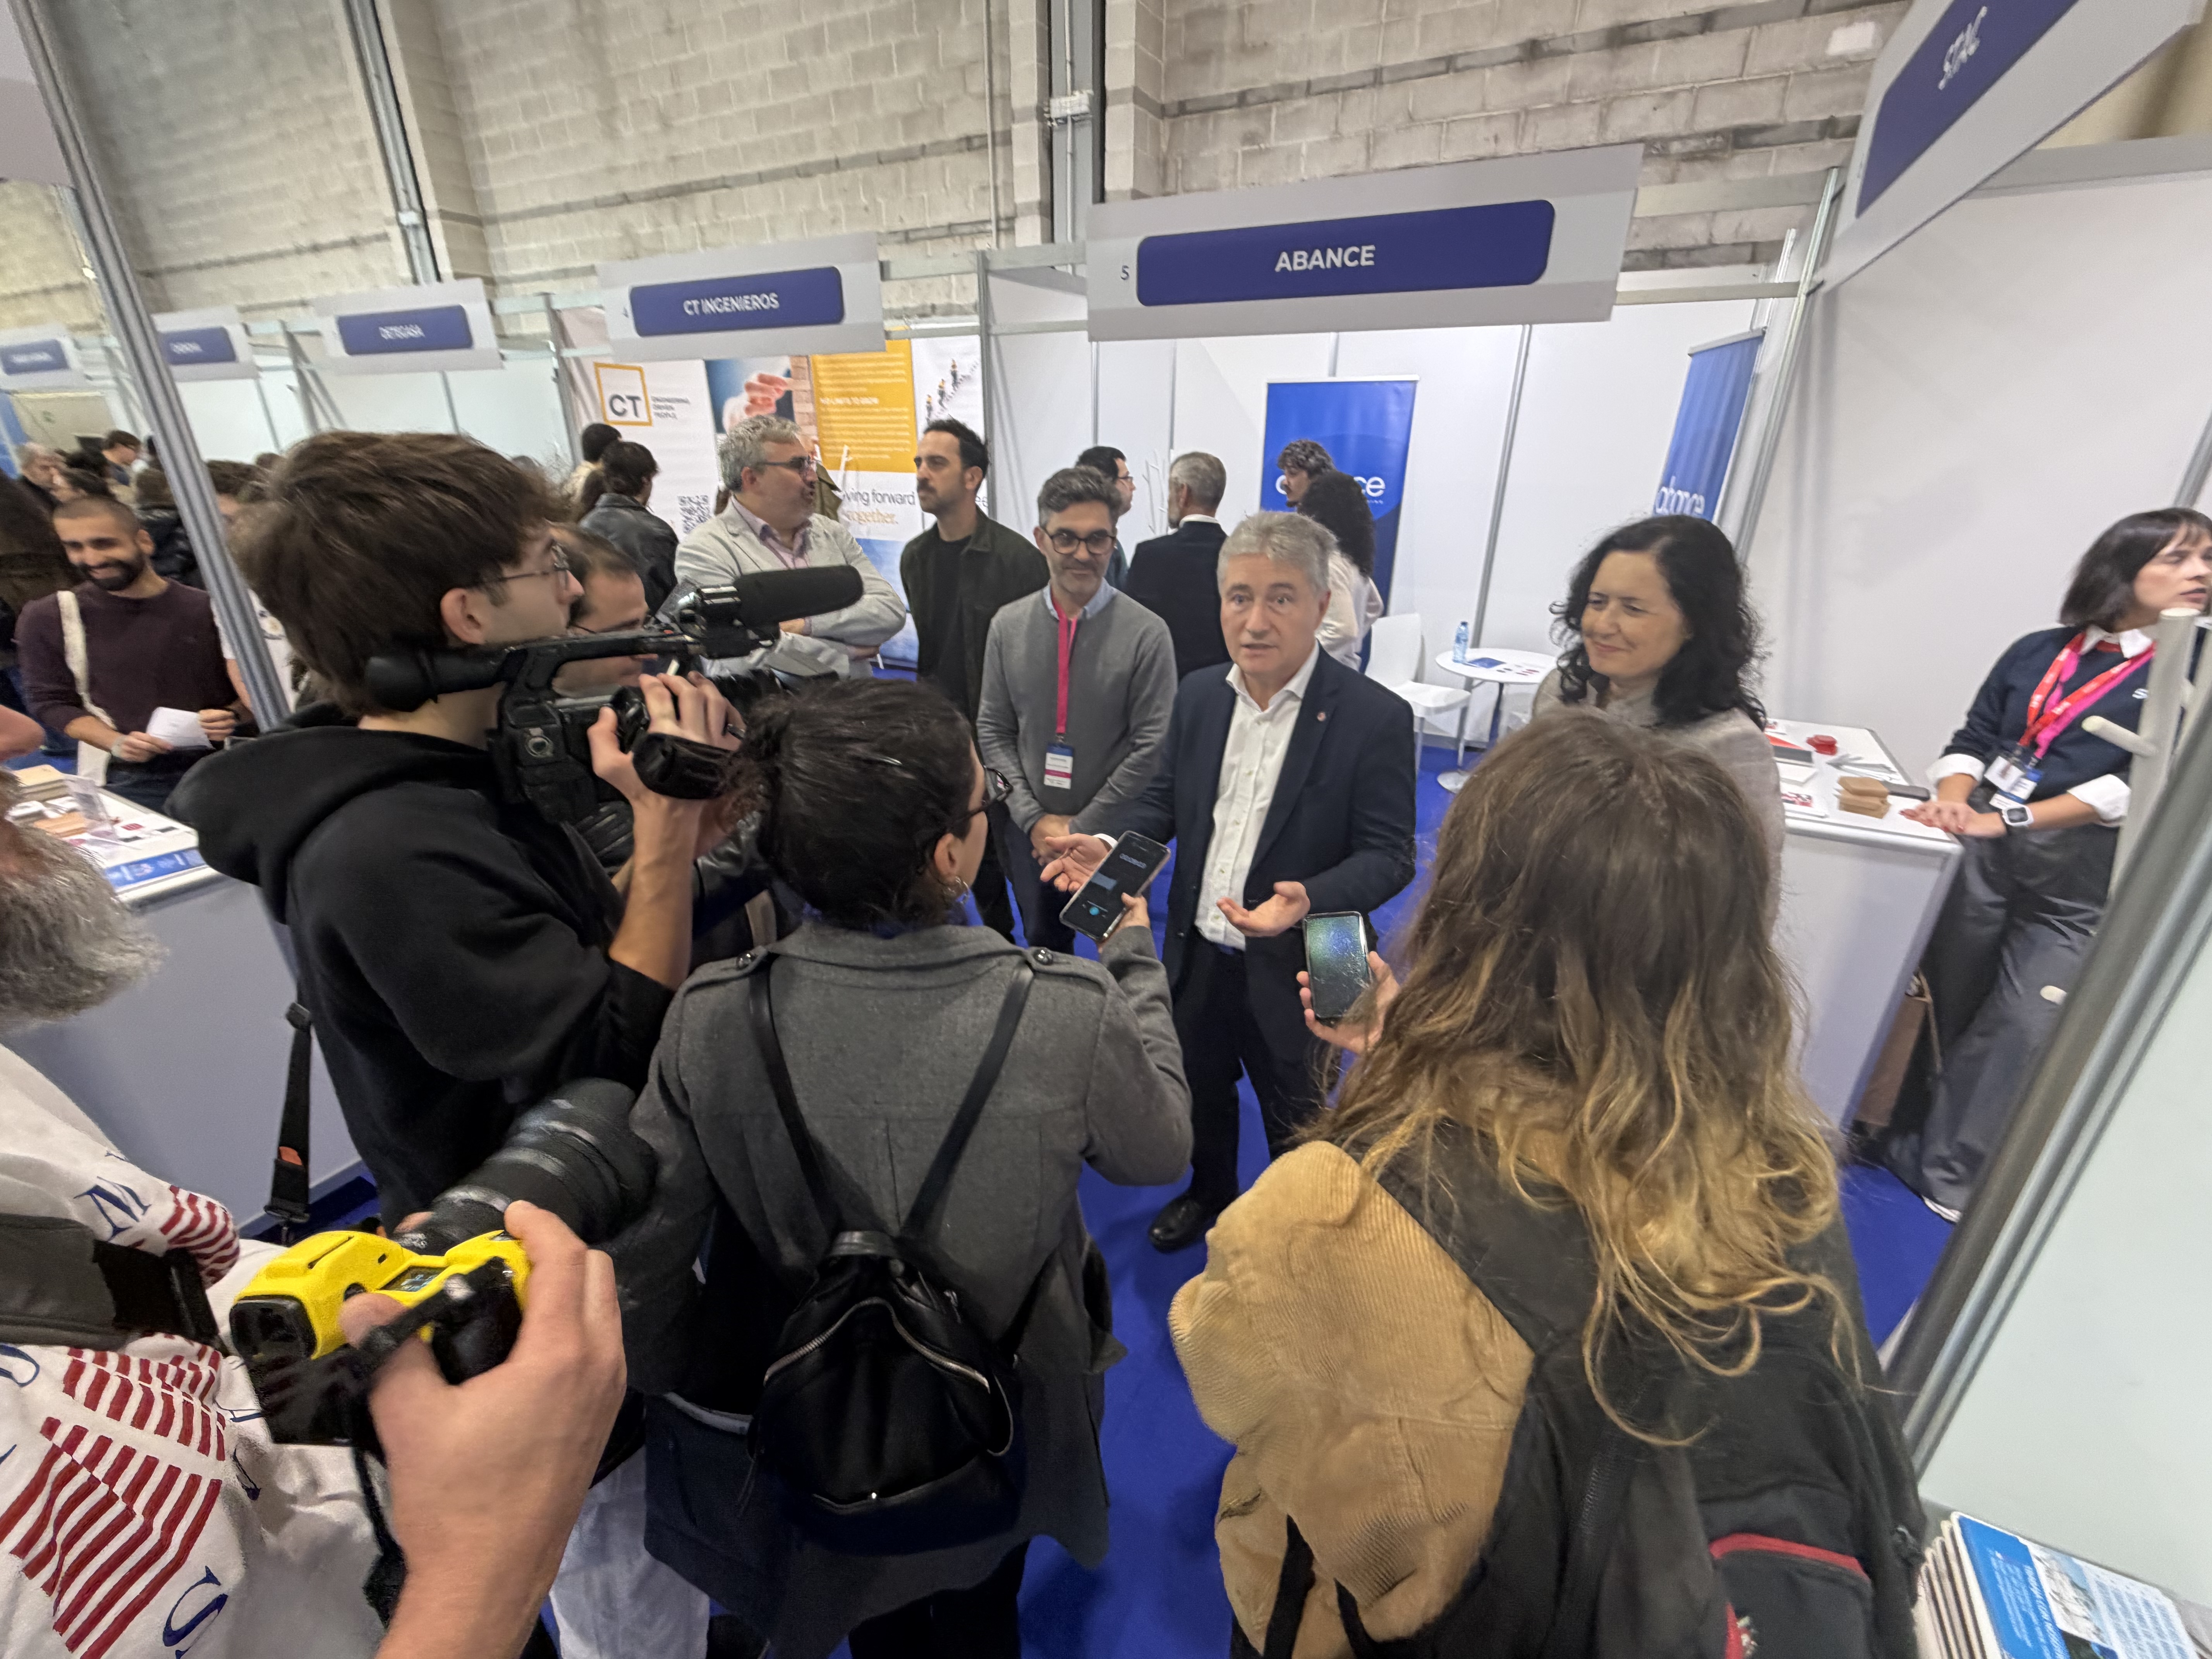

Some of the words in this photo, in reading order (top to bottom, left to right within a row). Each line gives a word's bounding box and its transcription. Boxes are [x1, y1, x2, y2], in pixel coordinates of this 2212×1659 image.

[1274, 245, 1376, 272] ABANCE
[1120, 265, 1130, 281] 5
[683, 300, 700, 316] CT
[701, 292, 780, 315] INGENIEROS
[609, 394, 641, 418] CT
[871, 489, 915, 505] forward
